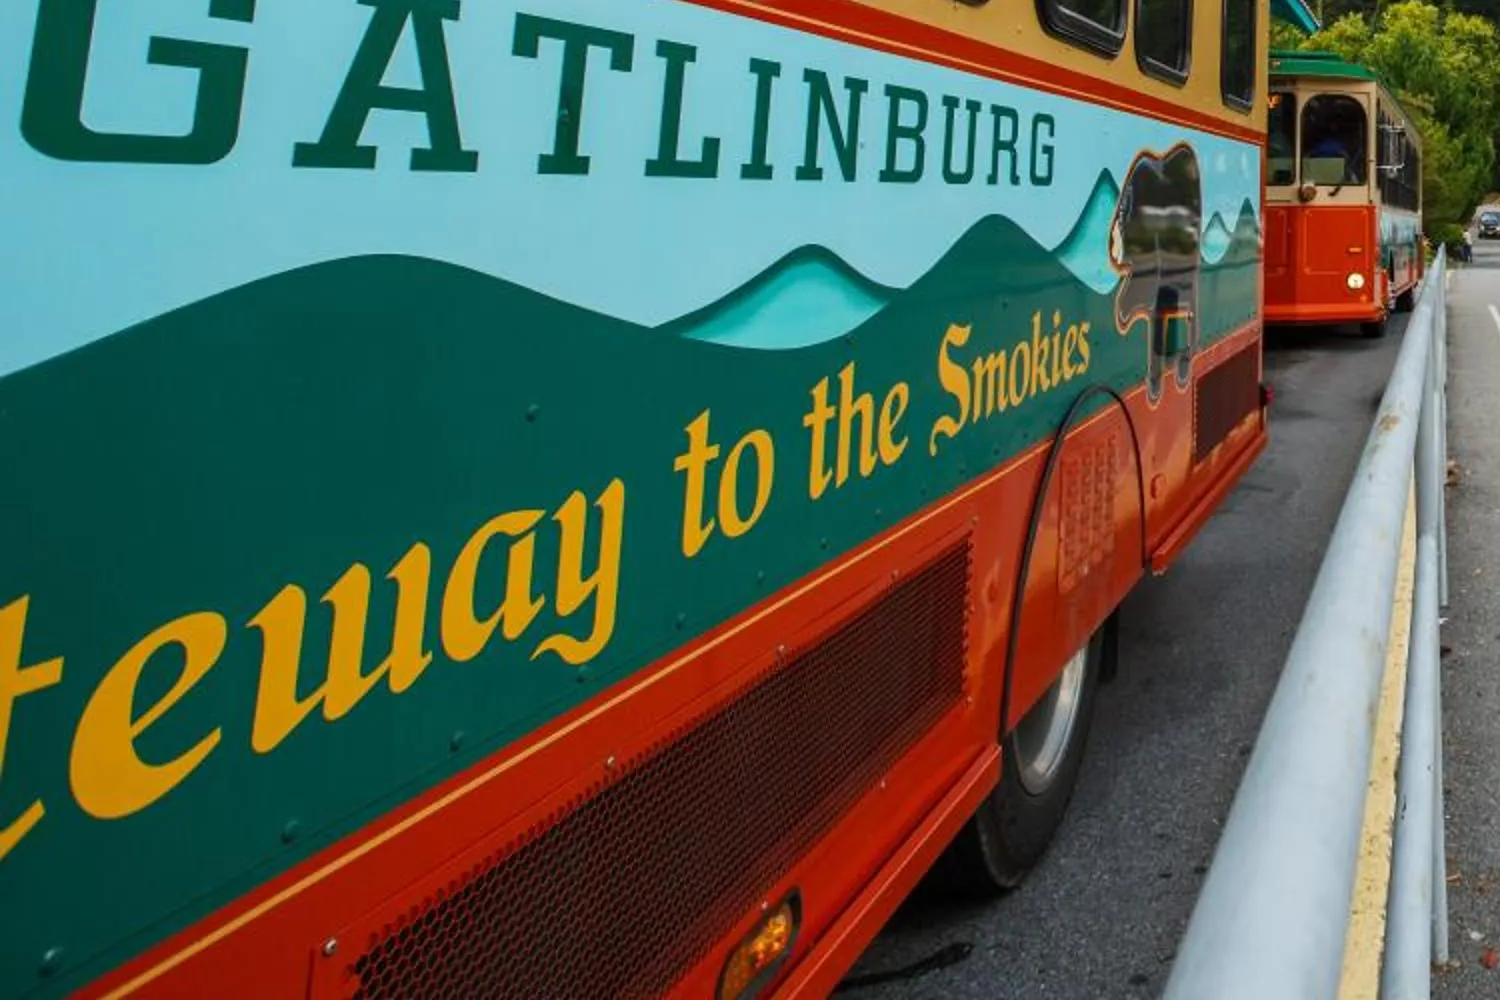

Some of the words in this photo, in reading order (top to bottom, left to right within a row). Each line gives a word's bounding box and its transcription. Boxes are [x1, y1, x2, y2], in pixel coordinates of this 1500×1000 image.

[674, 409, 774, 558] to
[804, 361, 909, 499] the
[929, 309, 1091, 457] Smokies
